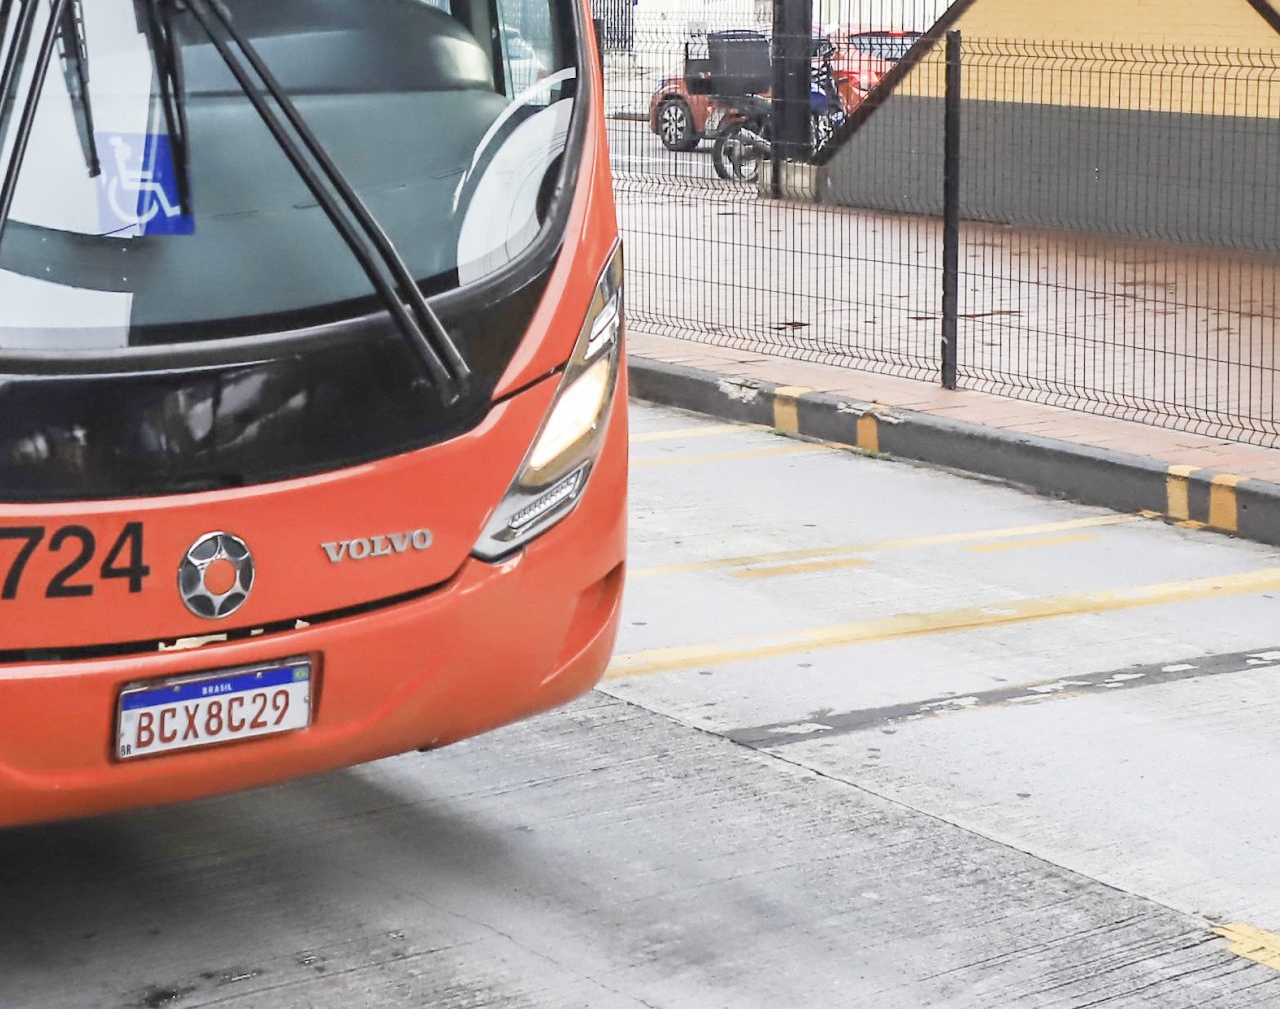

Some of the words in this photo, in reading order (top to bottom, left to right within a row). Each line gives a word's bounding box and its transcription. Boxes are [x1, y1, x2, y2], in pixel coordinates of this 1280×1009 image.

[322, 529, 433, 564] VOLVO
[201, 683, 233, 695] BRASIL
[136, 689, 290, 749] BCX8C29
[120, 744, 132, 756] BR
